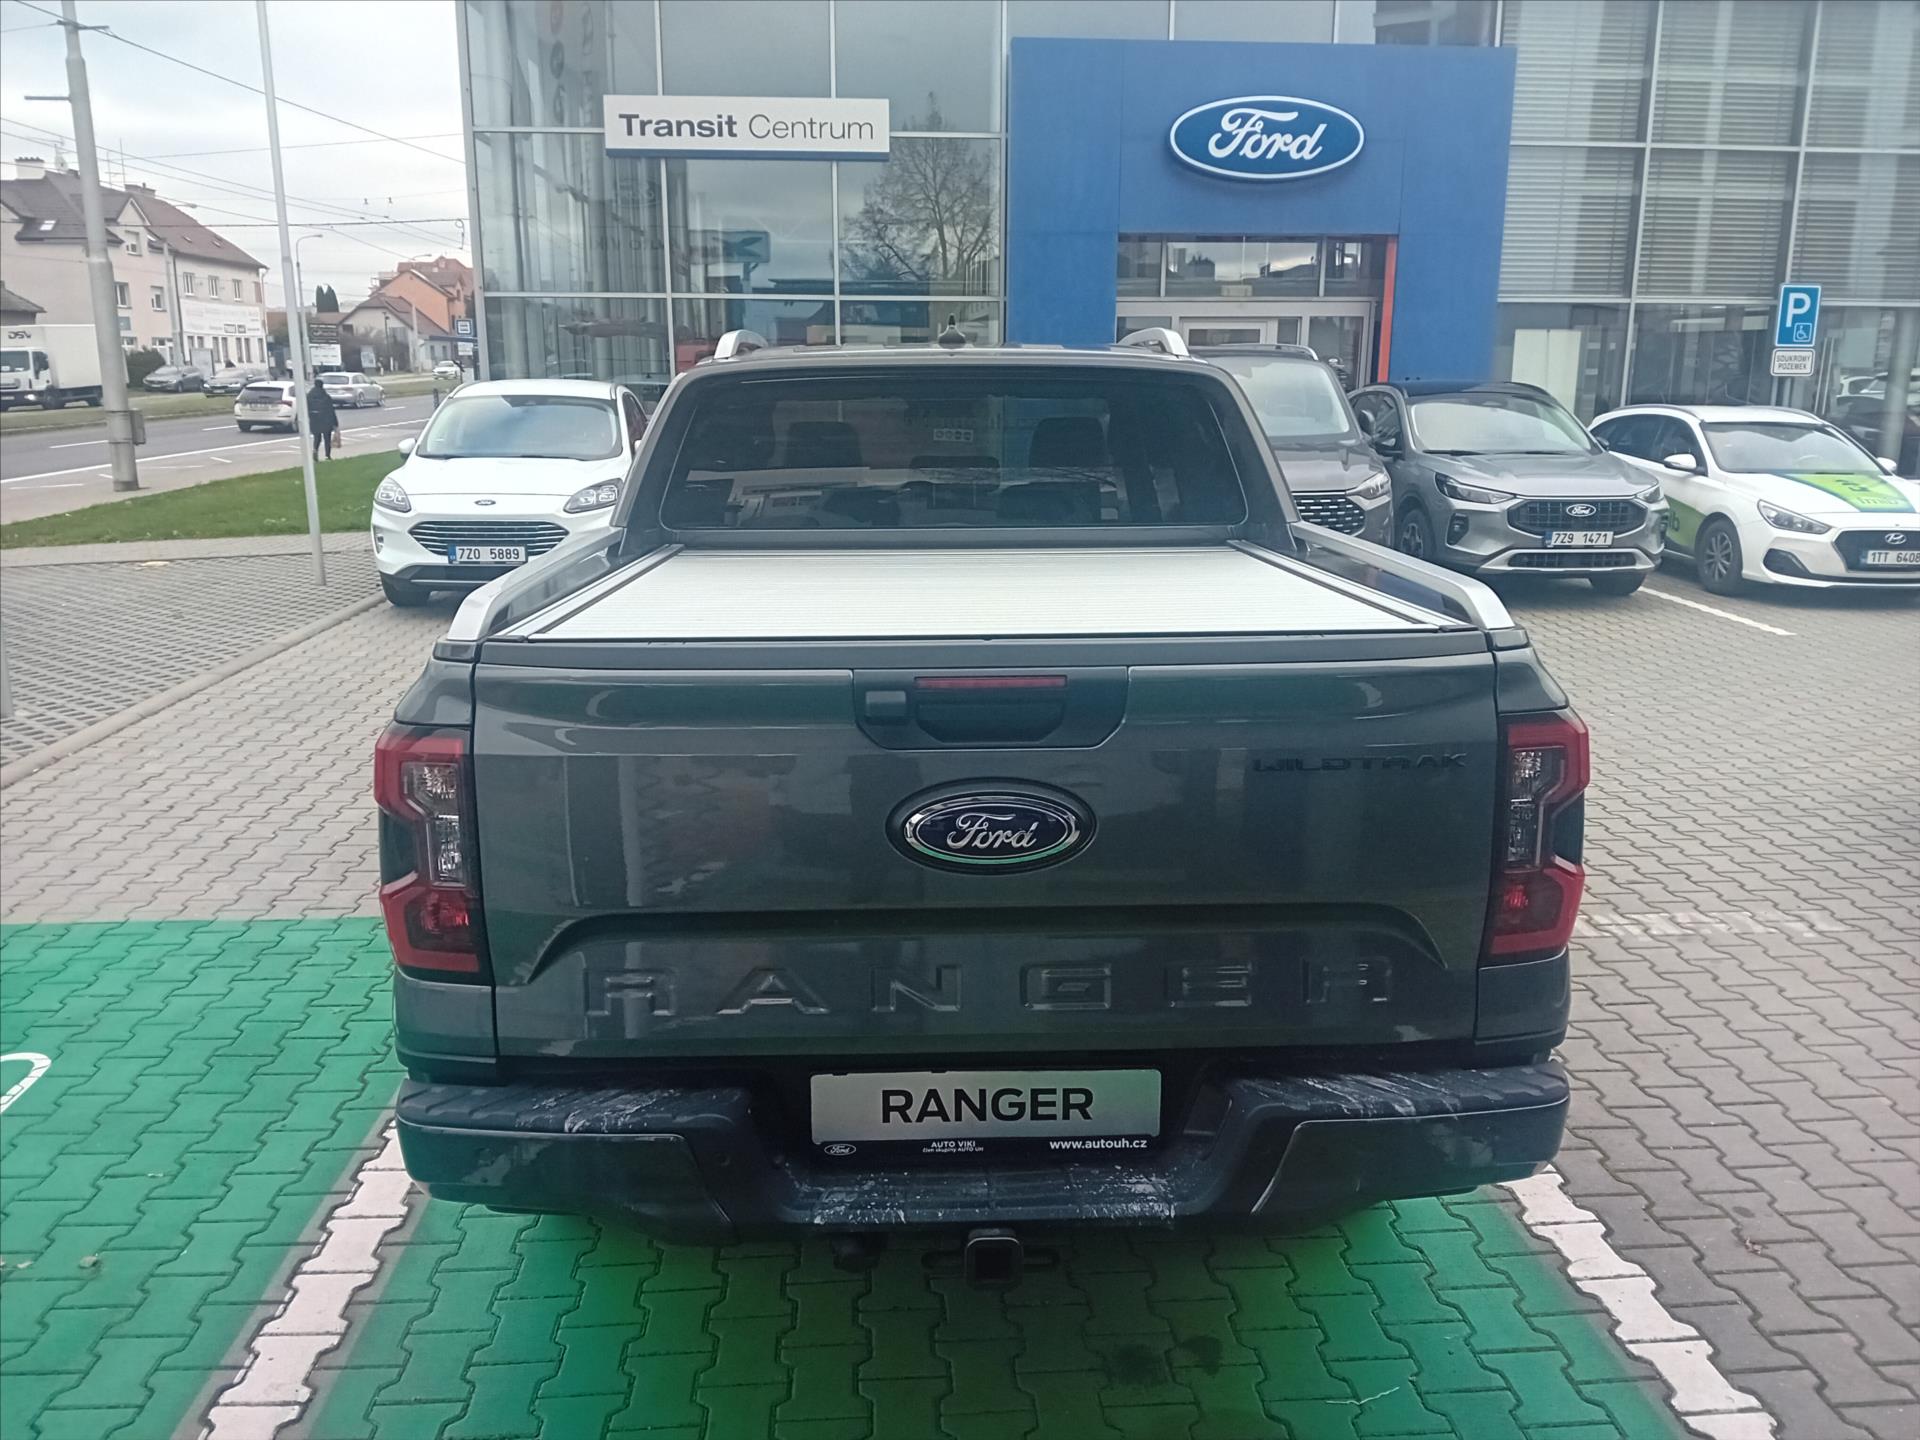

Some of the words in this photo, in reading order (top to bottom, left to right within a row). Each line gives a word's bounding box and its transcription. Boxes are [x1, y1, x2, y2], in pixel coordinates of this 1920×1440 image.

[618, 113, 738, 138] Transit
[748, 113, 875, 140] Centrum
[1208, 107, 1328, 160] Ford
[1785, 292, 1812, 328] P
[8, 331, 32, 339] DSV
[1553, 533, 1574, 544] 7Z9
[1583, 533, 1608, 544] 1471
[489, 547, 520, 560] 5889
[1871, 552, 1889, 563] 1TT
[1896, 552, 1920, 564] 6408
[1253, 753, 1467, 772] WILDTRAK
[946, 812, 1039, 849] Ford
[584, 963, 1393, 1016] RANGER
[881, 1088, 1094, 1123] RANGER
[1049, 1138, 1148, 1150] www.autouh.cz
